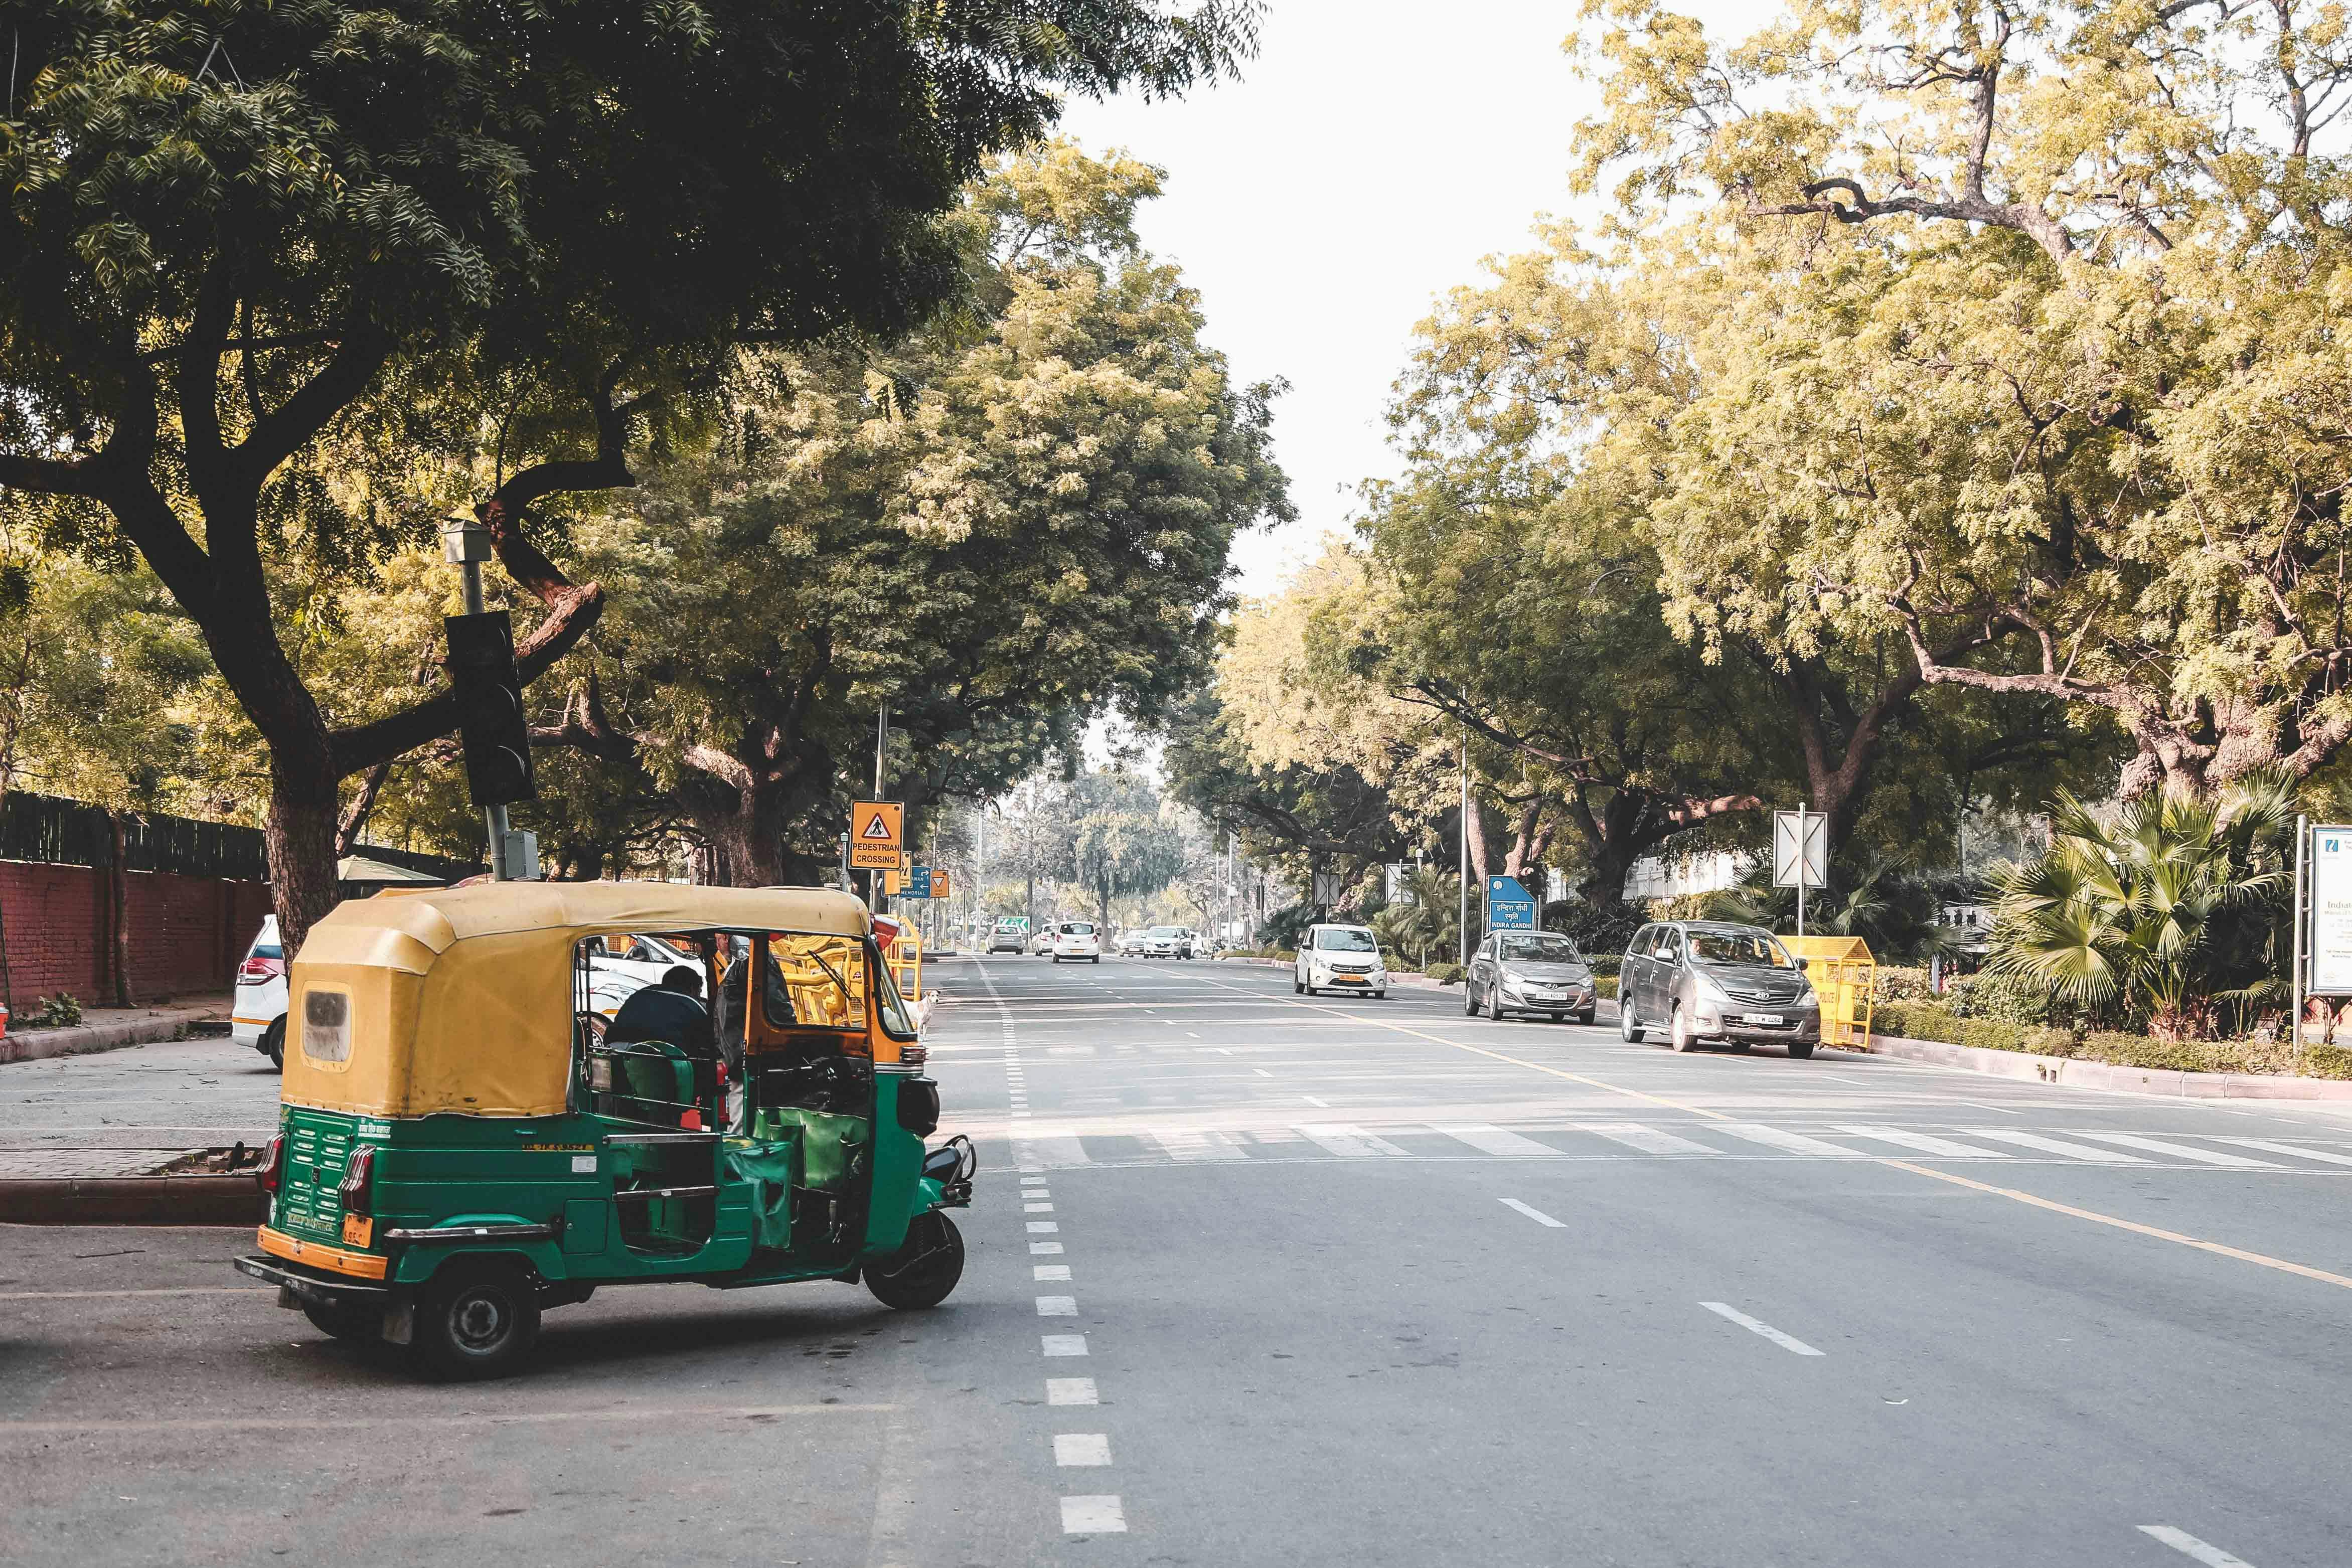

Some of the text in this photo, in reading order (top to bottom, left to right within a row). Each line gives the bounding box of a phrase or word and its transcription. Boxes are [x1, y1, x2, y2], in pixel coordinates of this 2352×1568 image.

[853, 843, 899, 851] PEDESTRIAN
[856, 855, 895, 863] CROSSING
[1504, 912, 1518, 921] स्मृति
[1819, 992, 1834, 1003] POLICE
